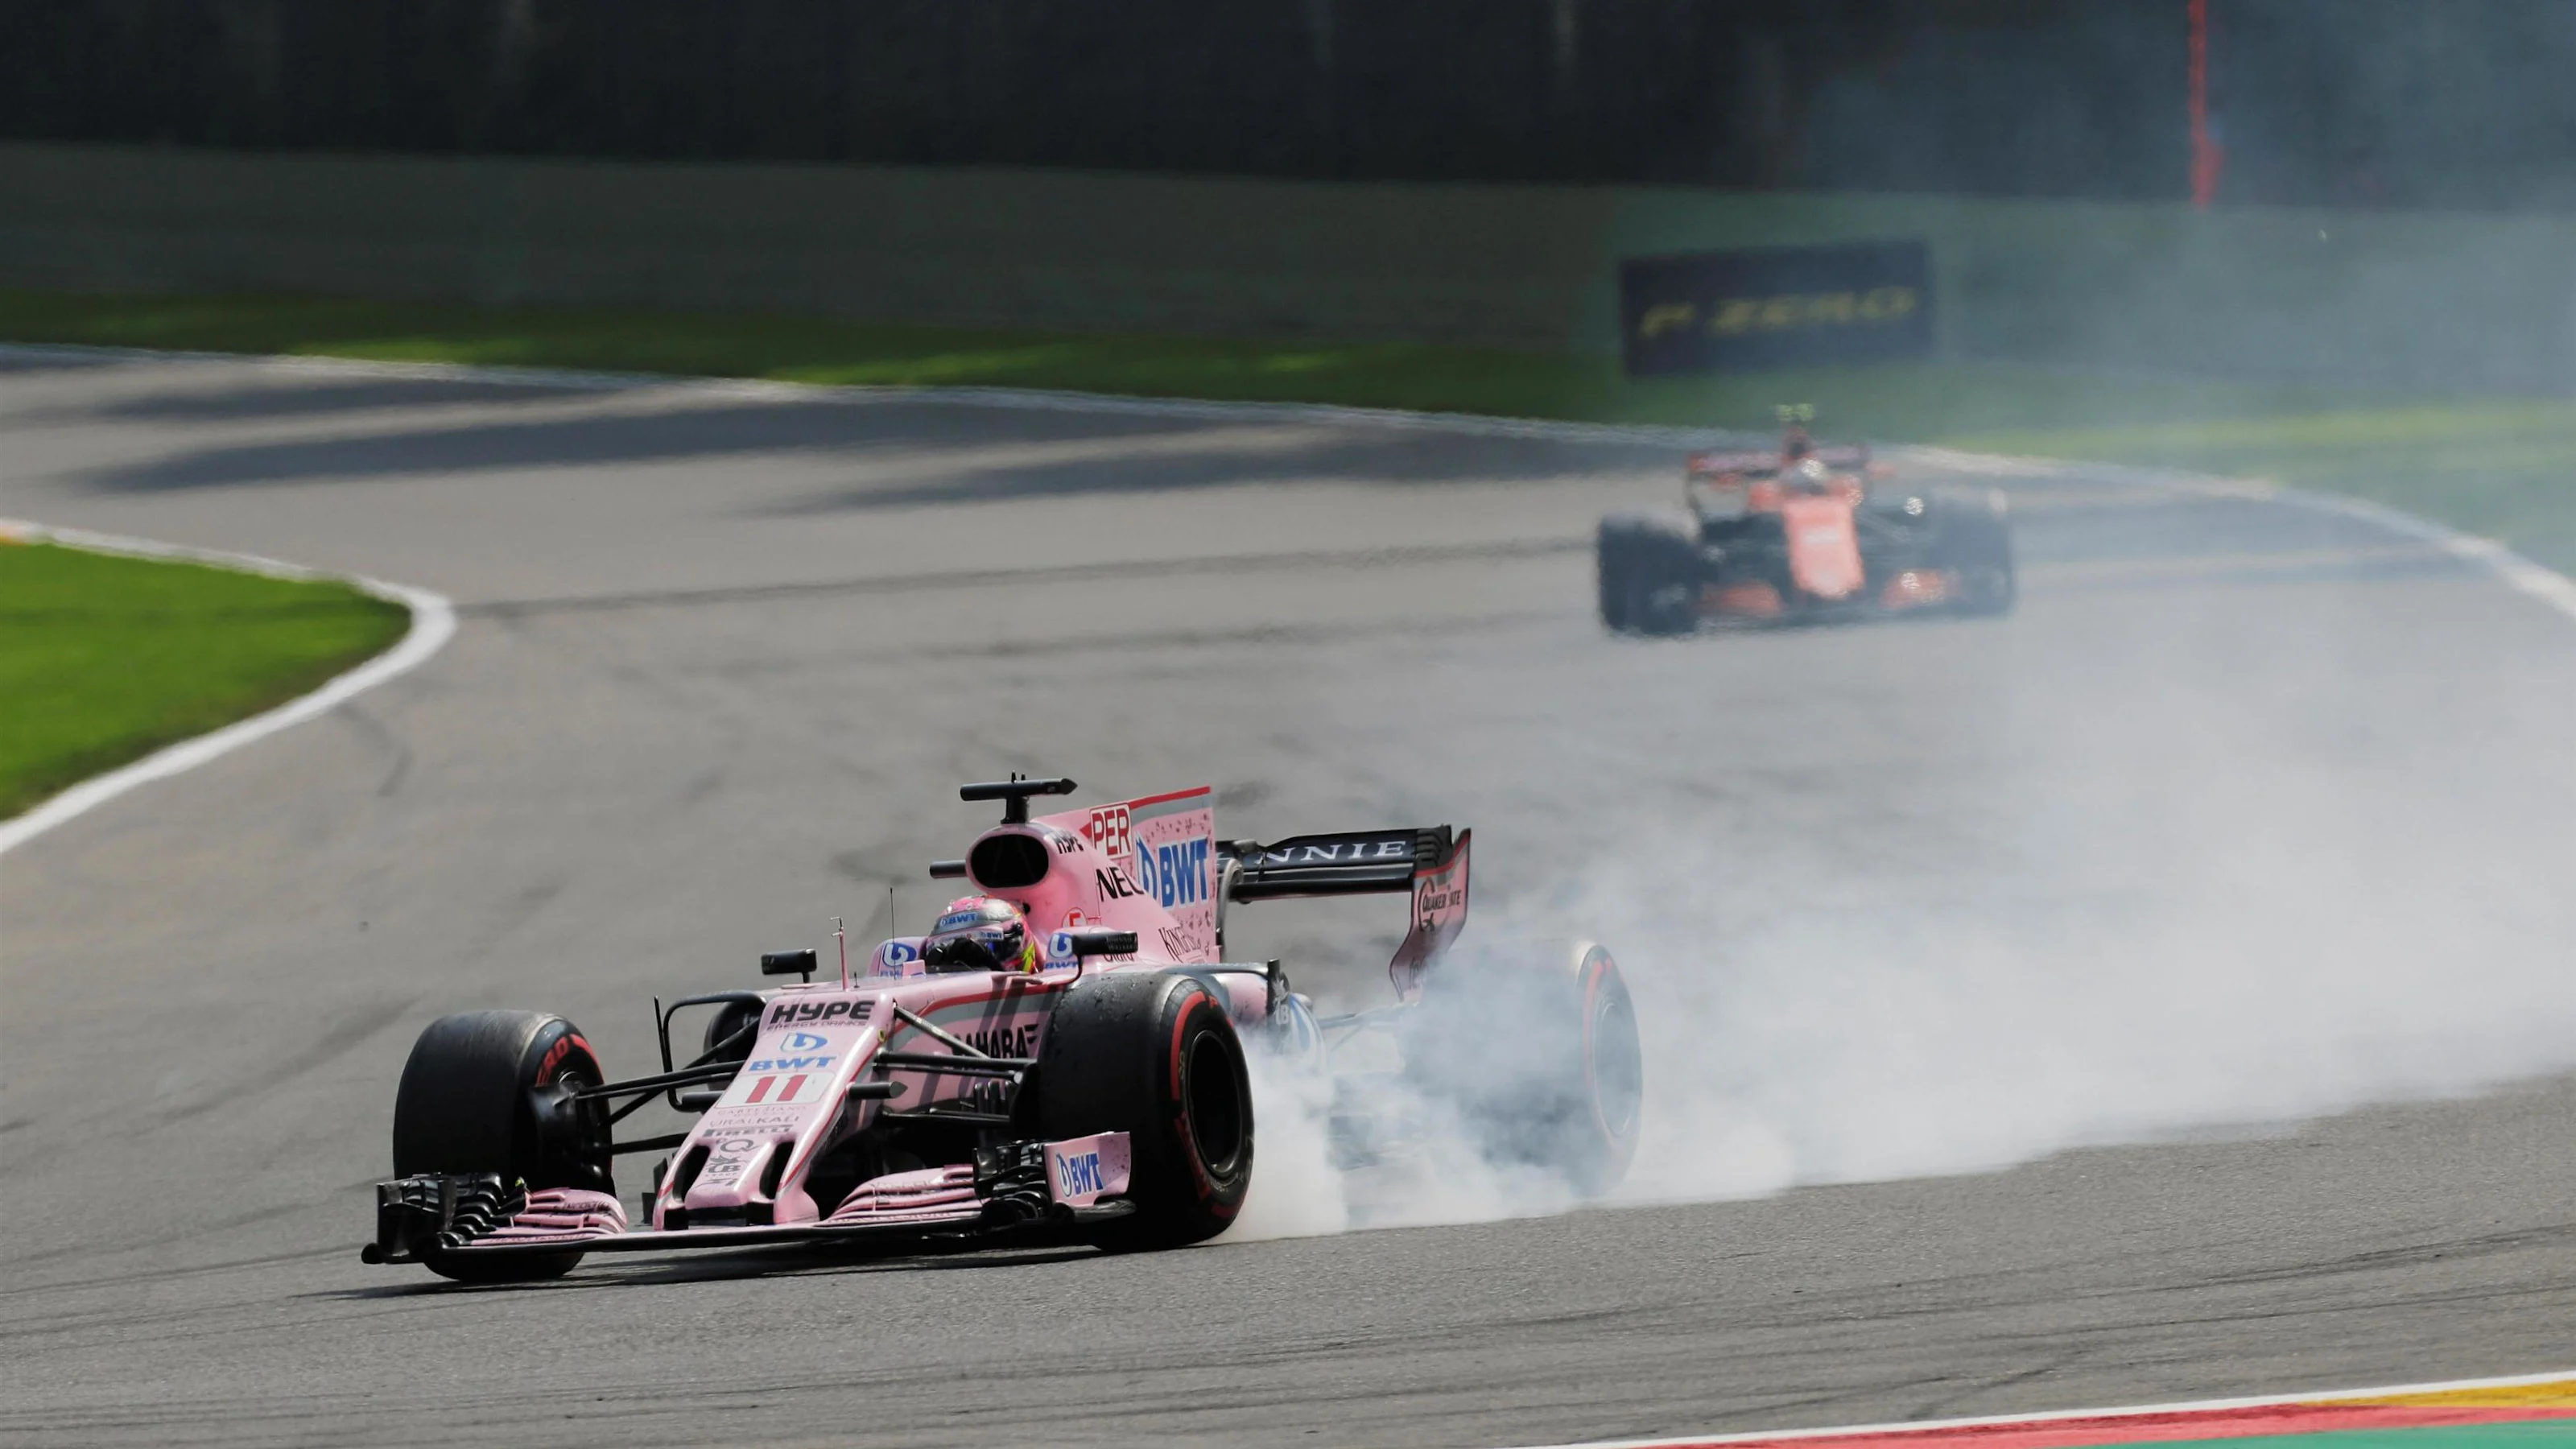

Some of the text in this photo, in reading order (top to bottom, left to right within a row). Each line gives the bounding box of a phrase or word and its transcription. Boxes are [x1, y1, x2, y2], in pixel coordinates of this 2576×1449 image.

[1092, 807, 1131, 856] PER
[1158, 836, 1208, 908] BWT
[1422, 894, 1447, 913] QUAKER
[947, 912, 976, 924] BWT
[770, 1001, 876, 1024] HYPE
[749, 1056, 837, 1072] BWT
[745, 1074, 809, 1104] 11
[710, 1116, 799, 1127] URALKALI
[1069, 1152, 1104, 1195] BWT
